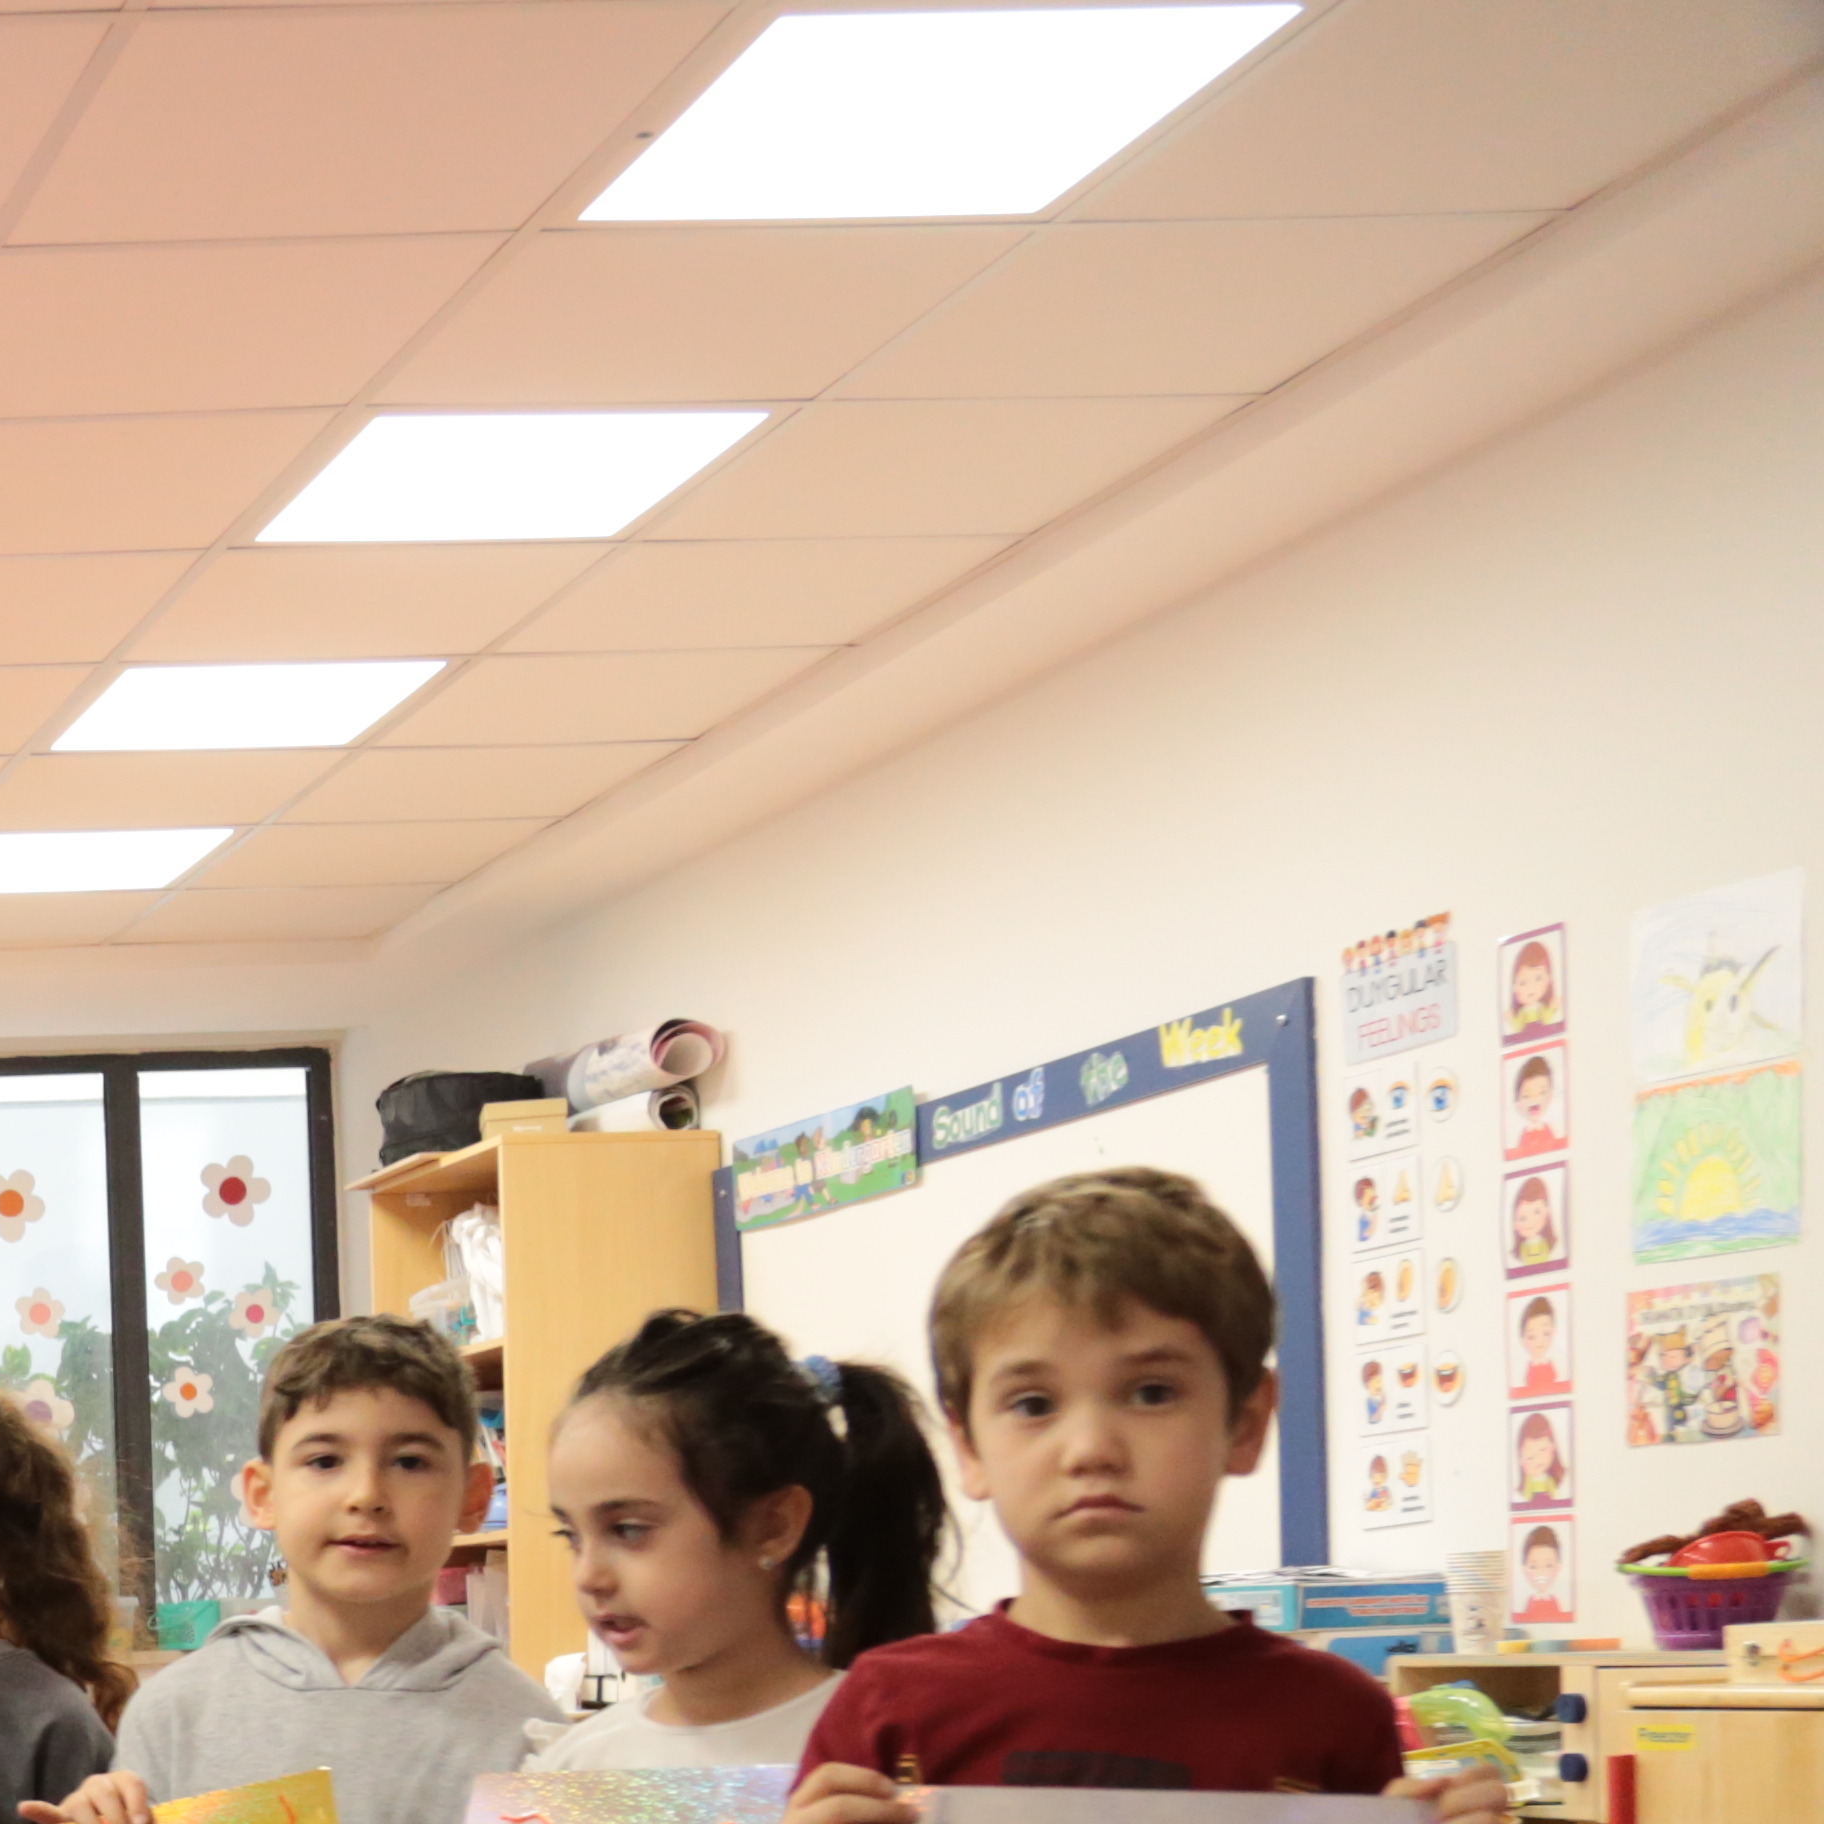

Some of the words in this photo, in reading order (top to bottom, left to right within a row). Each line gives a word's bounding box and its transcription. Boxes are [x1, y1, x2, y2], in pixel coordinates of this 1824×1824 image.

[1347, 959, 1449, 1014] DUYGULAR
[1358, 1003, 1442, 1050] FEELINGS
[932, 1081, 1003, 1150] Sound
[1013, 1067, 1044, 1121] of
[1080, 1051, 1129, 1107] the
[1159, 1006, 1243, 1068] Week
